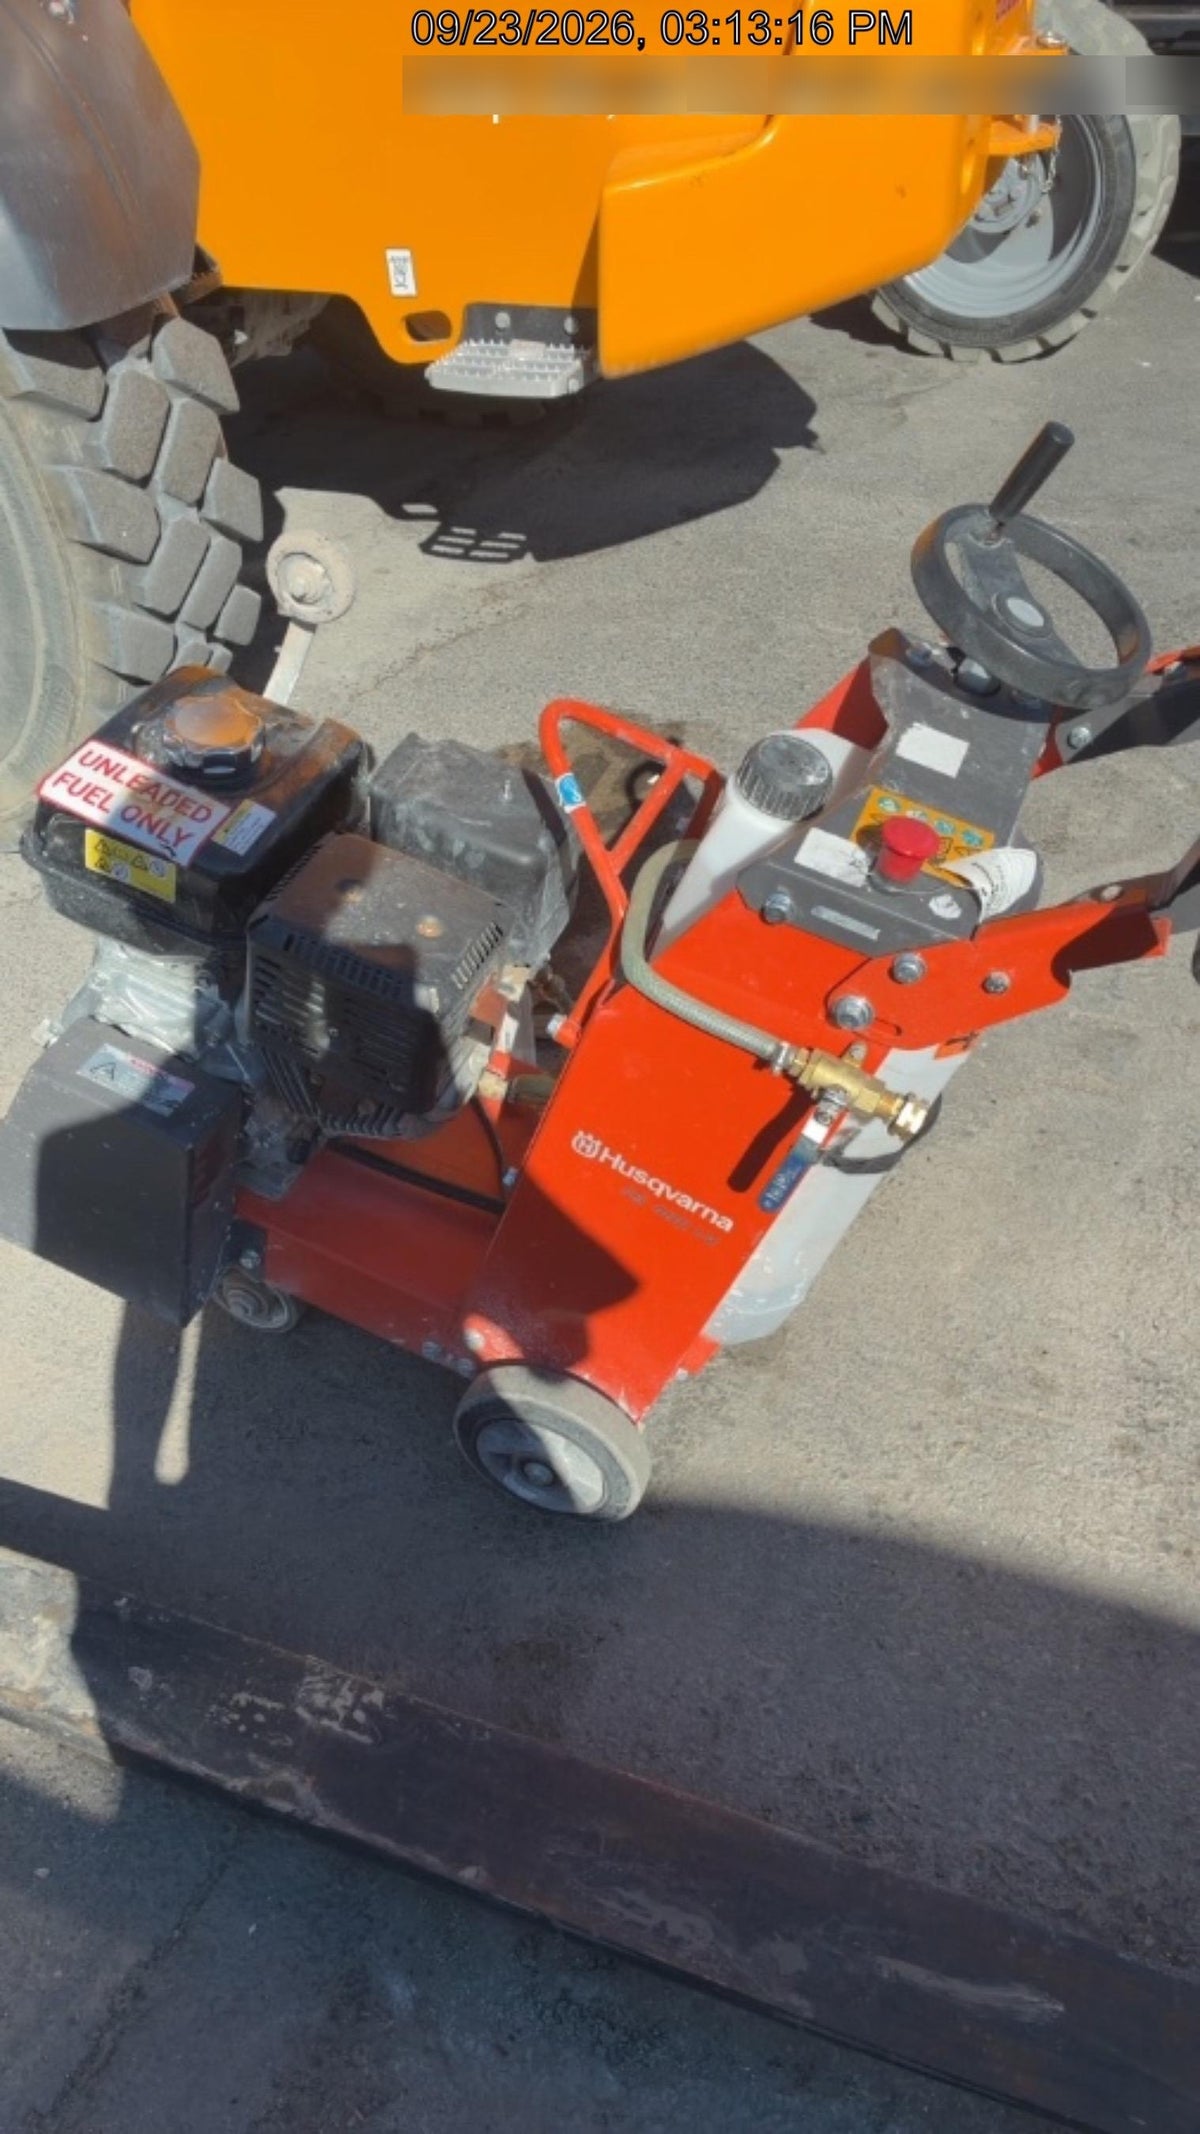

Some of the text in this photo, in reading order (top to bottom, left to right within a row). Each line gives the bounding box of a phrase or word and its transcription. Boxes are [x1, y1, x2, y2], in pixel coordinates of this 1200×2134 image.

[52, 772, 114, 814] FUEL
[120, 805, 195, 847] ONLY
[78, 750, 212, 823] UNLEADED
[598, 1146, 735, 1233] Husqvarna
